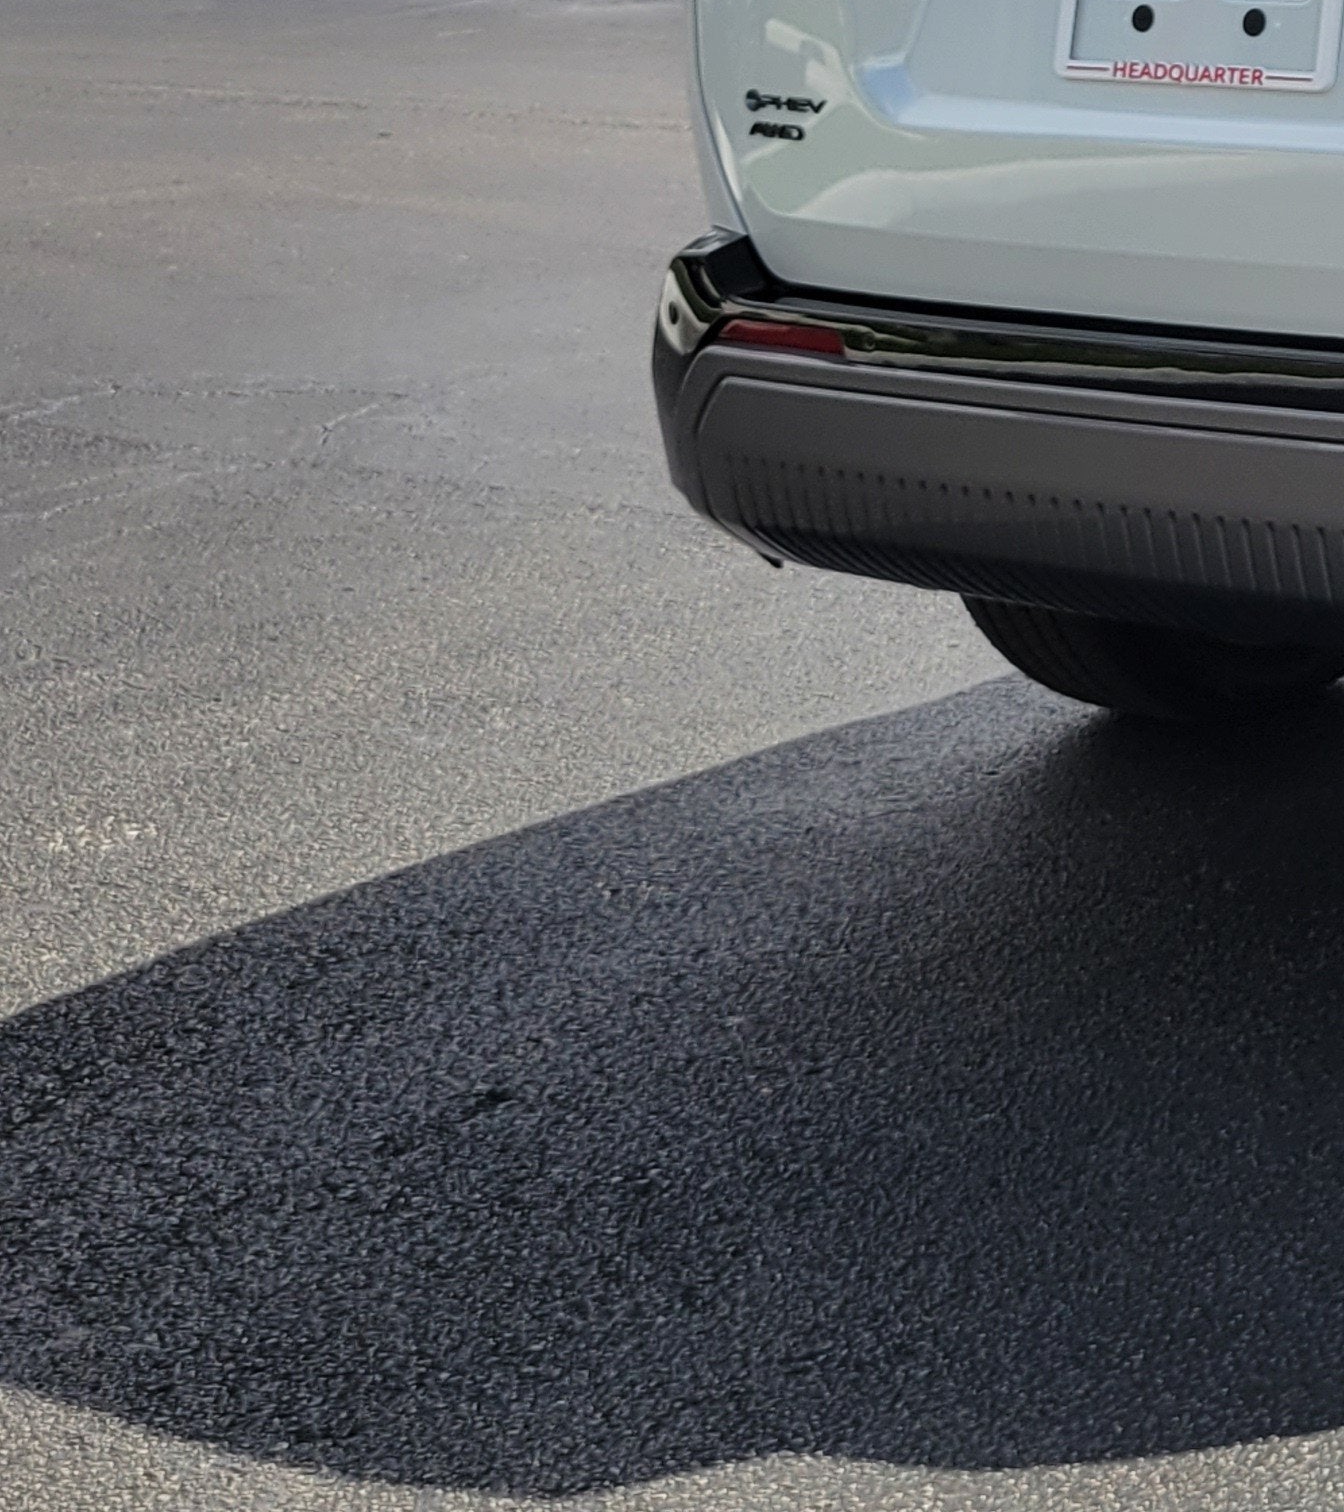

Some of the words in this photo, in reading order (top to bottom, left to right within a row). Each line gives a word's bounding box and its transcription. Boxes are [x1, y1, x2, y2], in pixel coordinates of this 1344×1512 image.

[1112, 61, 1264, 86] HEADQUARTER
[758, 94, 828, 115] PHEV
[749, 121, 805, 141] AWD
